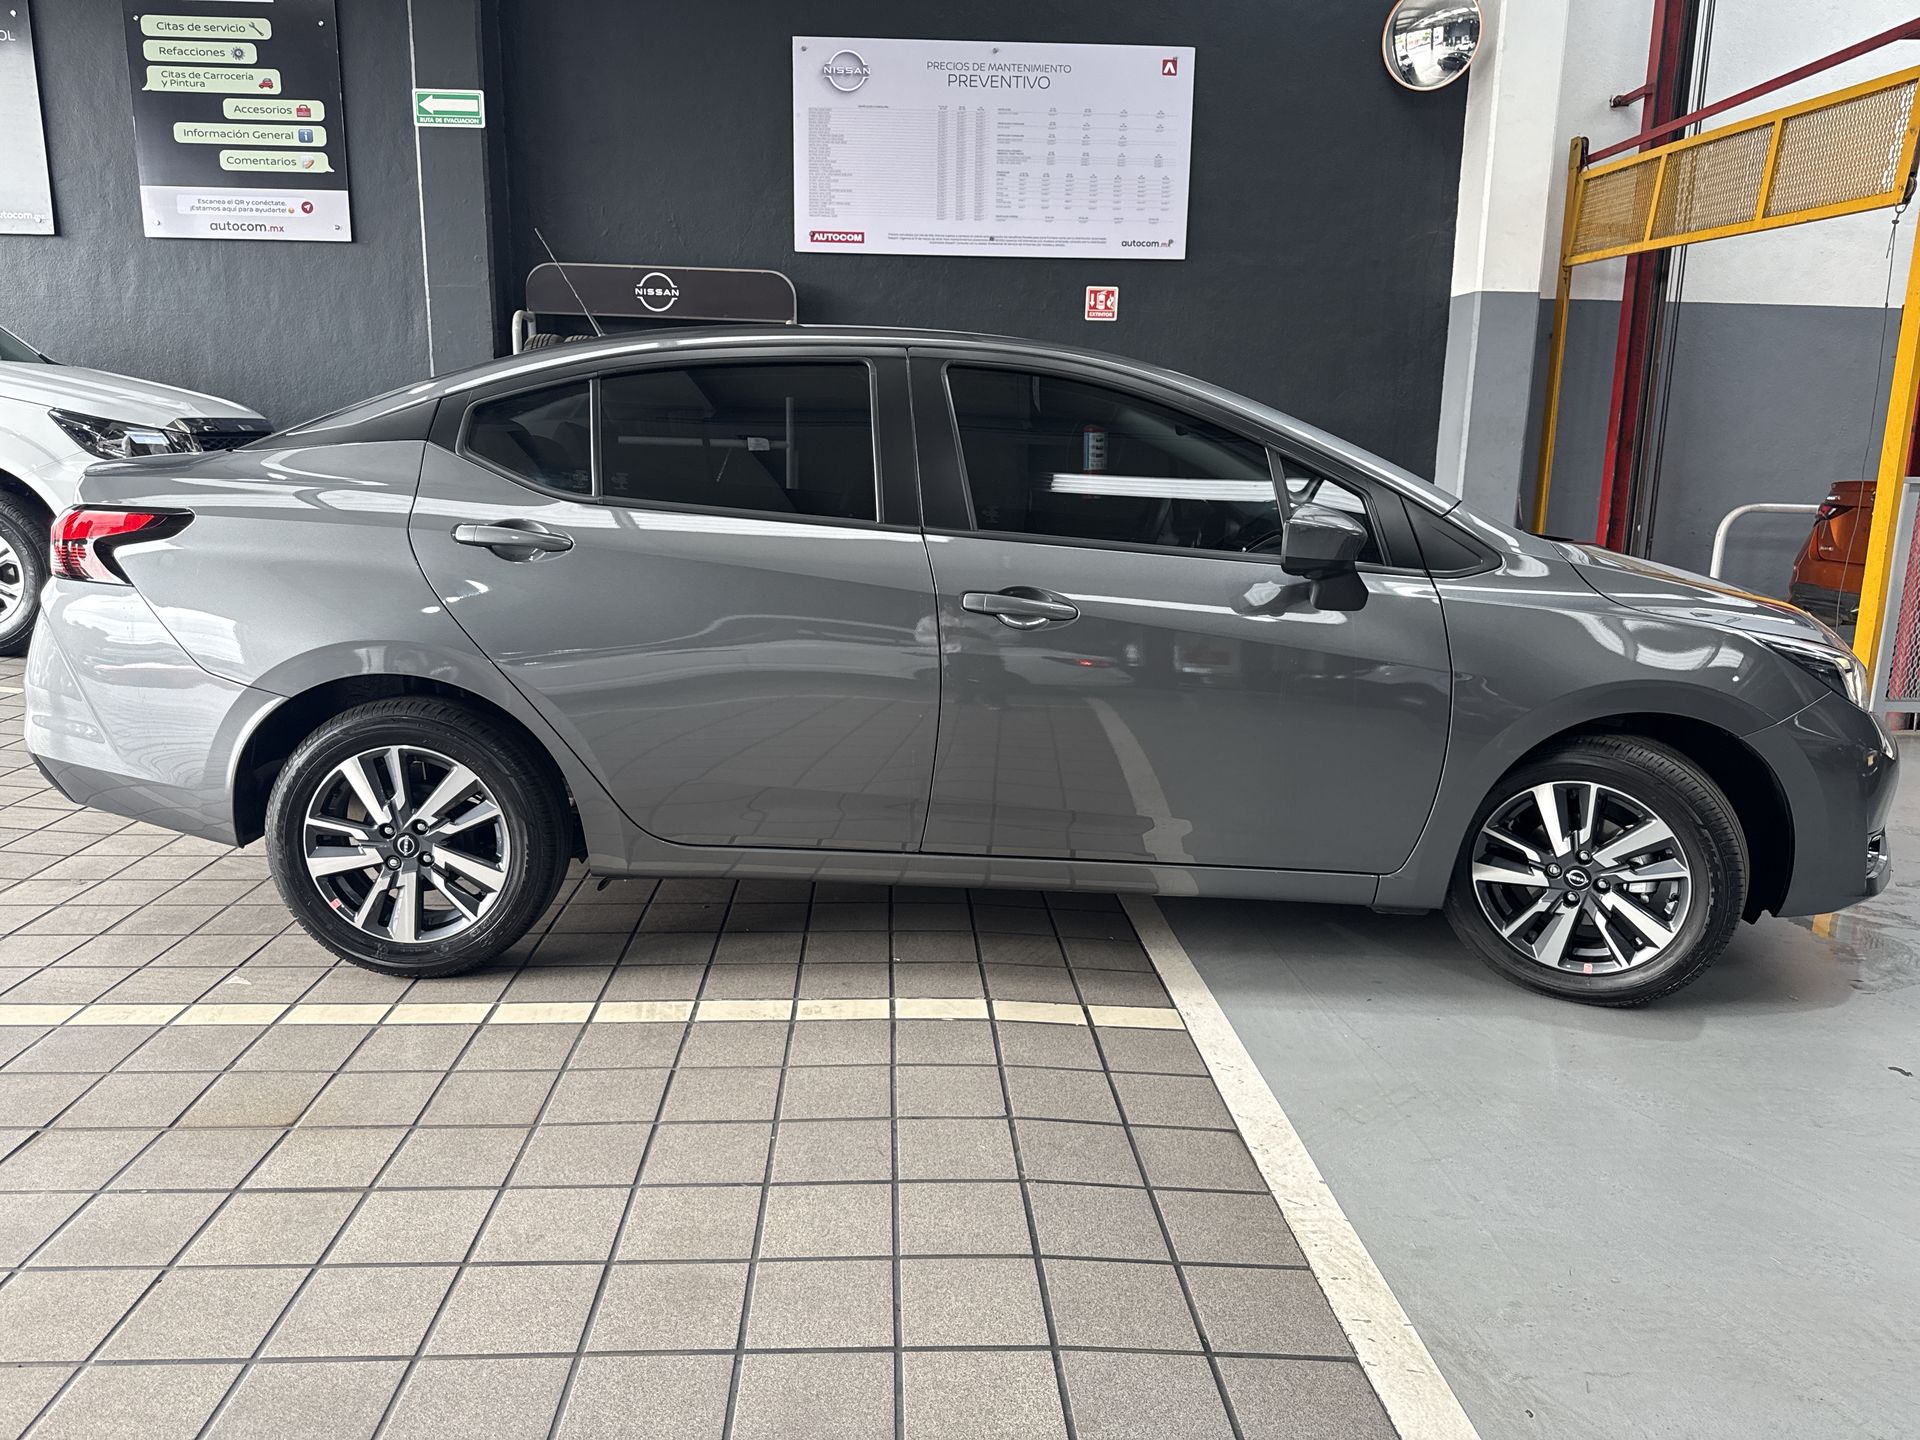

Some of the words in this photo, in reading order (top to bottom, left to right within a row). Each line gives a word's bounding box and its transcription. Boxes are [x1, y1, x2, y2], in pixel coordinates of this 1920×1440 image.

[156, 21, 184, 31] Citas
[187, 22, 201, 32] de
[204, 23, 246, 33] servicio
[158, 46, 226, 57] Refacciones
[823, 66, 871, 75] NISSAN
[926, 61, 970, 71] PRECIOS
[972, 62, 986, 72] DE
[988, 63, 1072, 74] MANTENIMIENTO
[160, 70, 187, 79] Citas
[189, 70, 201, 79] de
[203, 71, 254, 81] Carrocería
[161, 80, 168, 88] y
[169, 79, 206, 88] Pintura
[947, 73, 1051, 90] PREVENTIVO
[233, 105, 293, 115] Accesorios
[183, 128, 250, 139] Información
[252, 130, 294, 140] General
[226, 155, 297, 167] Comentarios
[222, 205, 237, 214] aquí
[238, 206, 253, 214] para
[209, 220, 285, 233] autocom.mx
[813, 232, 863, 242] AUTOCOM
[635, 288, 679, 296] NISSAN
